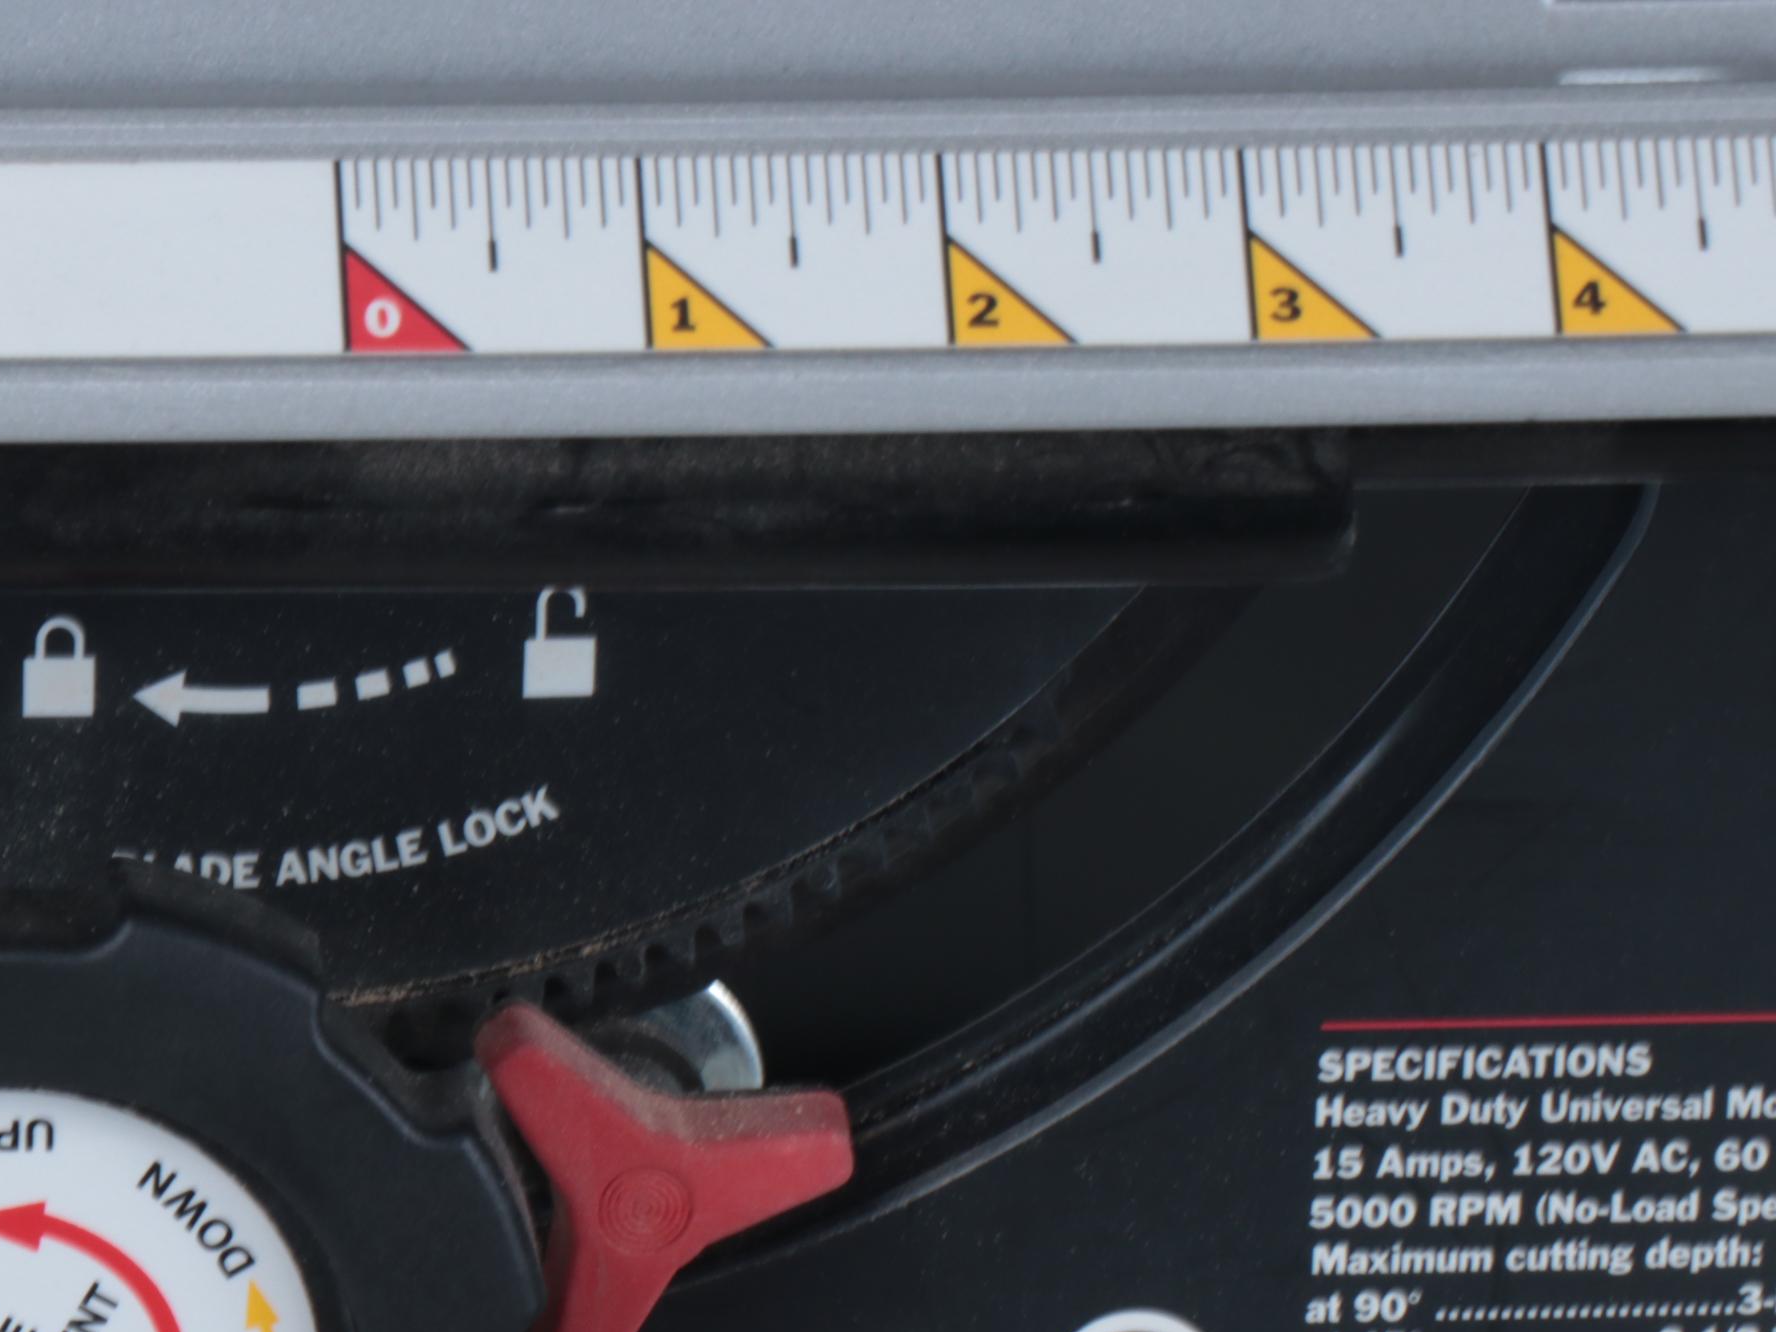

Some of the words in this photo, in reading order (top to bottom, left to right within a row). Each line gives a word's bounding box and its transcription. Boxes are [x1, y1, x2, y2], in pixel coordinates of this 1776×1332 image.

[365, 299, 401, 337] 0
[675, 298, 694, 330] 1
[971, 294, 997, 326] 2
[1274, 288, 1301, 321] 3
[1575, 282, 1605, 313] 4
[112, 849, 261, 890] ADE
[277, 829, 427, 886] ANGLE
[438, 786, 559, 856] LOCK
[1318, 1044, 1651, 1082] SPECIFICATIONS
[1315, 1095, 1428, 1131] Heavy
[1441, 1093, 1527, 1129] Duty
[1541, 1088, 1713, 1123] Universal
[1314, 1147, 1363, 1179] 15
[1376, 1146, 1495, 1182] Amps,
[1514, 1142, 1620, 1175] 120V
[1632, 1140, 1699, 1177] AC,
[1715, 1139, 1769, 1171] 60
[138, 1160, 255, 1279] DOWN
[1310, 1195, 1416, 1229] 5000
[1430, 1193, 1521, 1226] RPM
[1536, 1190, 1699, 1225] (No-Load
[1312, 1243, 1493, 1275] Maximum
[1506, 1239, 1633, 1275] cutting
[1645, 1236, 1762, 1273] depth:
[1305, 1293, 1341, 1323] at
